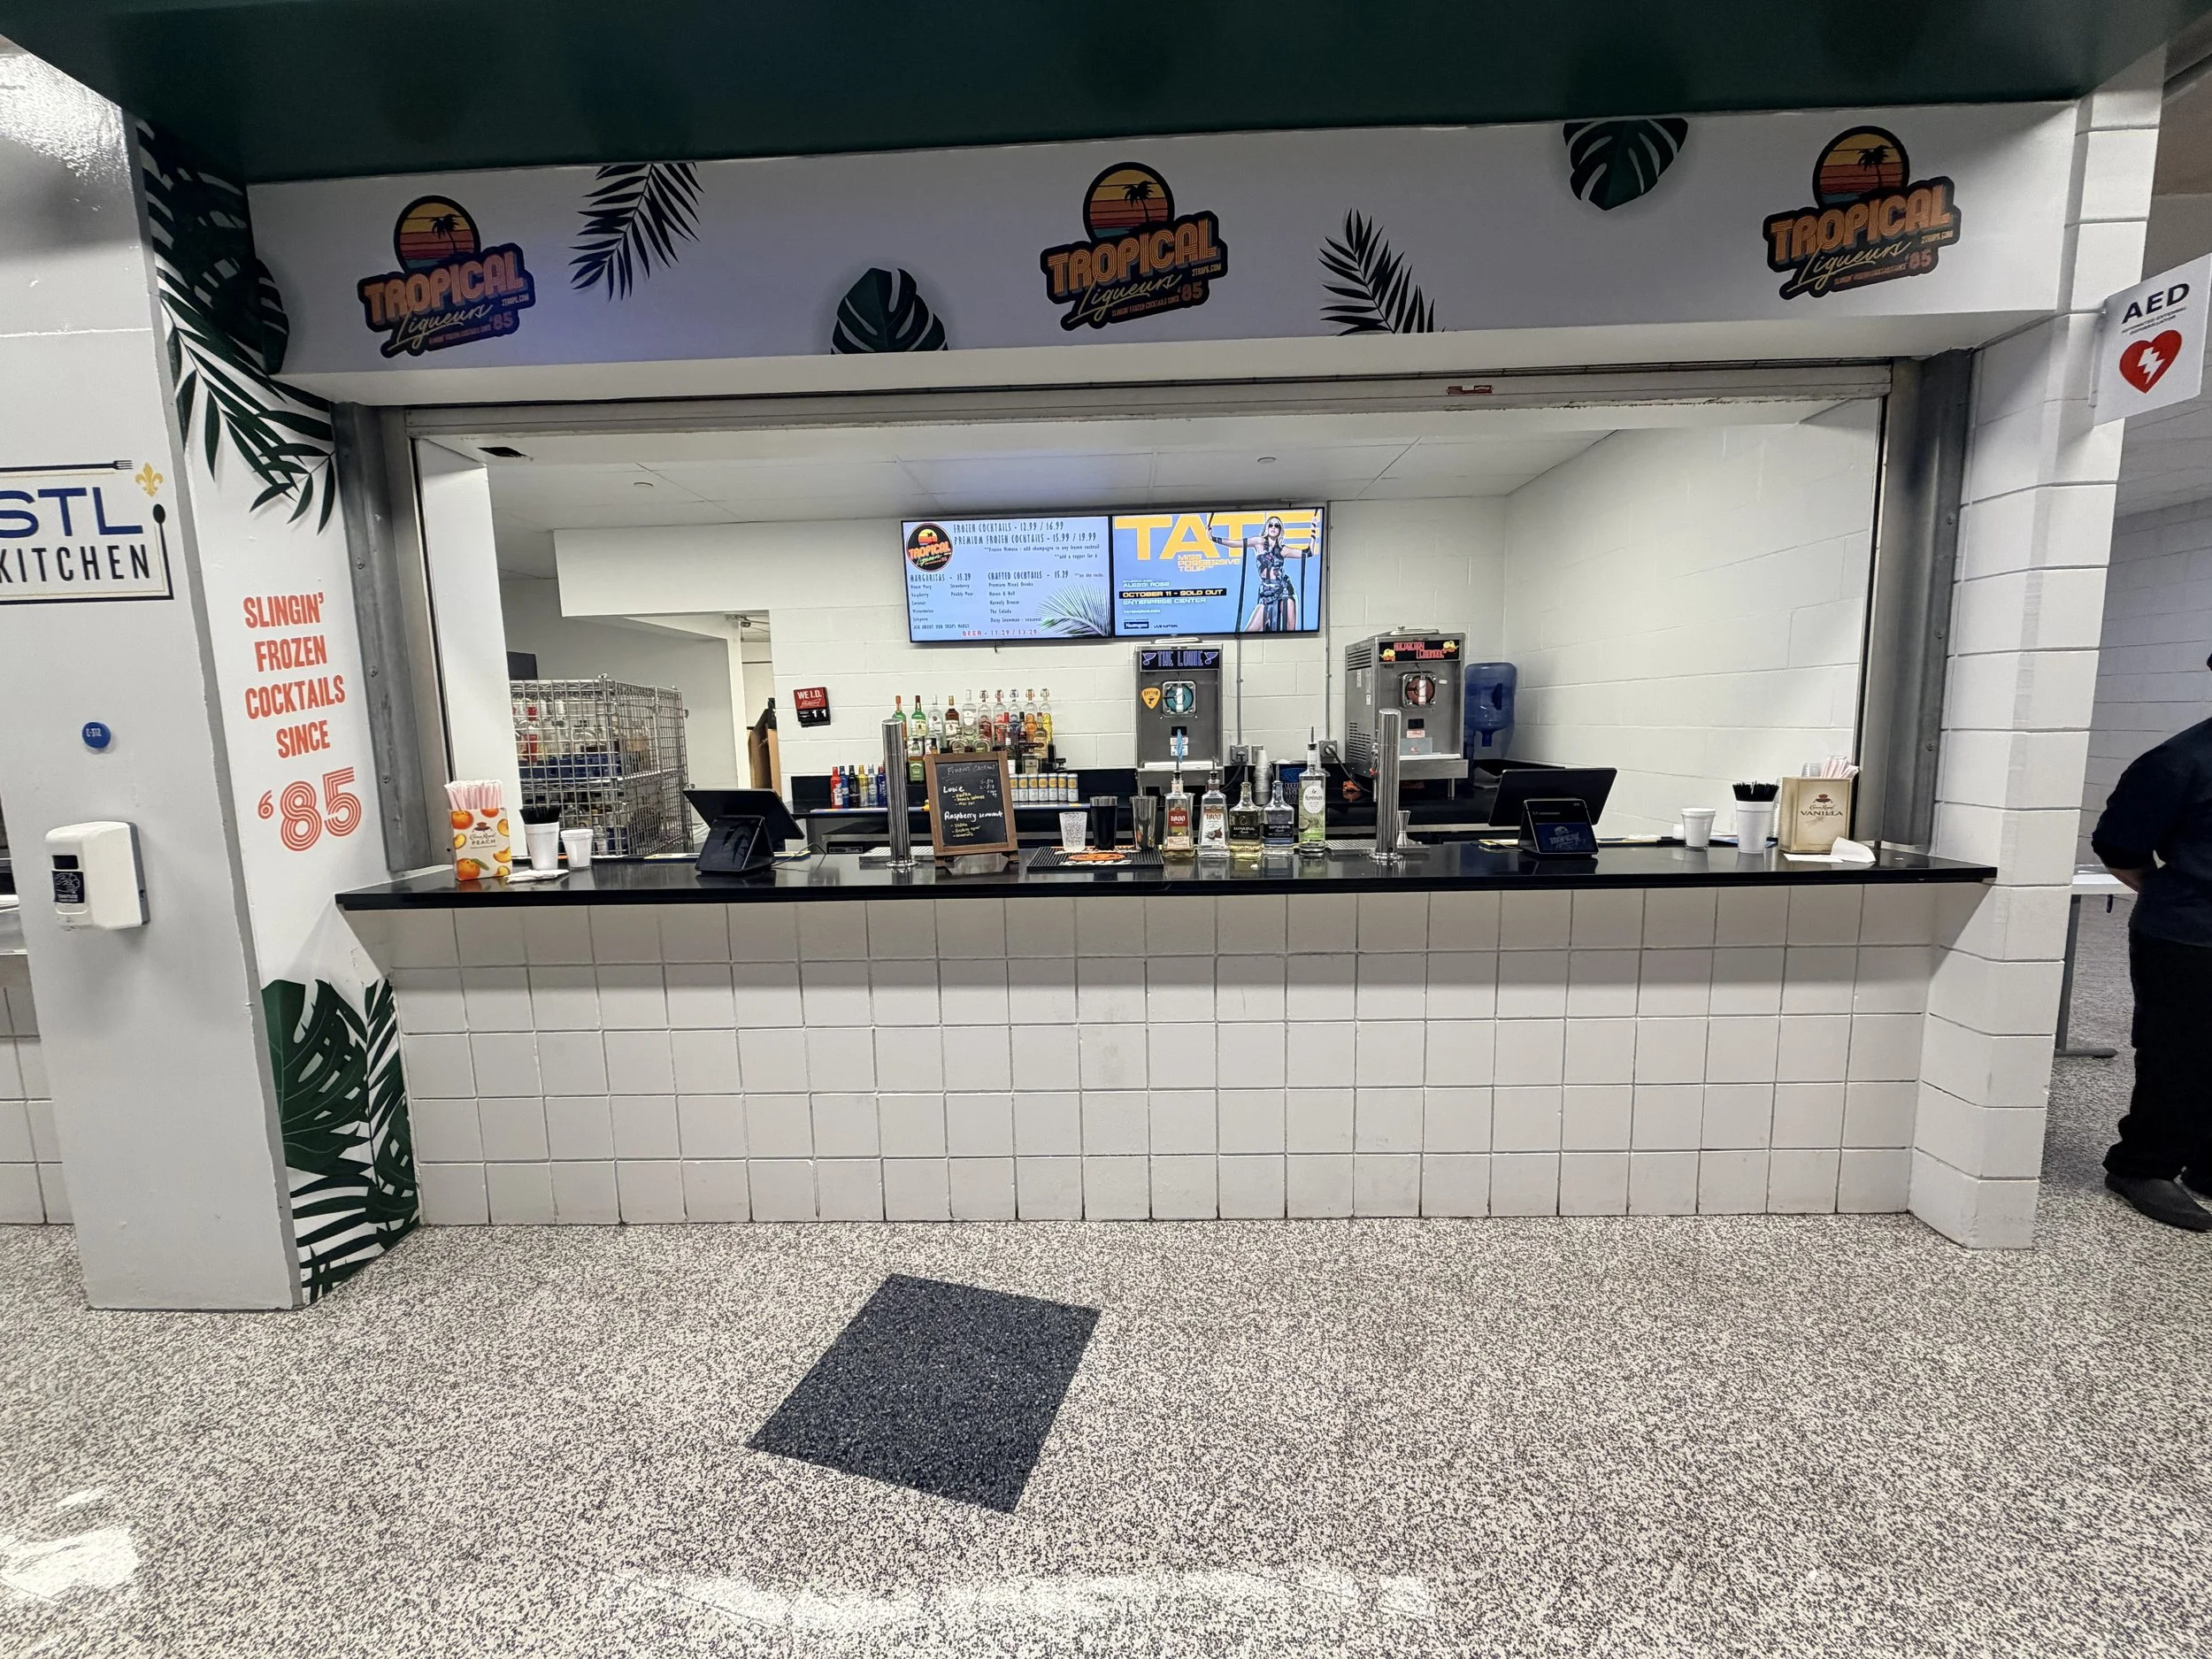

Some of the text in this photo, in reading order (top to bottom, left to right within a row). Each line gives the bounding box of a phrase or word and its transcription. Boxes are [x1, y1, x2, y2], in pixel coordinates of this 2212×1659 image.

[1770, 184, 1954, 264] TROPICAL
[1048, 219, 1220, 296] TROPICAL
[1787, 242, 1911, 292] Liqueurs
[364, 250, 525, 325] TROPICAL
[1067, 273, 1182, 324] Liqueurs
[2122, 283, 2190, 324] AED
[388, 304, 493, 350] Liqueurs
[0, 487, 143, 538] STL
[954, 524, 975, 533] FROZEN
[979, 523, 1011, 533] COCKTAILS
[1020, 522, 1037, 531] 12.99
[1046, 521, 1064, 531] 16.99
[908, 541, 950, 560] TROPICAL
[955, 536, 983, 545] PREMIUM
[987, 535, 1008, 544] FROZEN
[1012, 534, 1044, 543] COCKTAILS
[1053, 533, 1069, 542] 15.99
[1079, 532, 1096, 541] 19.99
[1114, 511, 1320, 561] TATE
[0, 544, 150, 583] KITCHEN
[910, 574, 945, 582] MARGARITAS
[988, 572, 1011, 580] CRAFTED
[1014, 571, 1042, 580] COCKTAILS
[243, 592, 324, 628] SLINGIN'
[254, 634, 327, 672] FROZEN
[245, 674, 345, 718] COCKTAILS
[797, 691, 810, 699] WE
[276, 719, 330, 758] SINCE
[257, 766, 361, 852] '85
[944, 811, 976, 822] Raspberry
